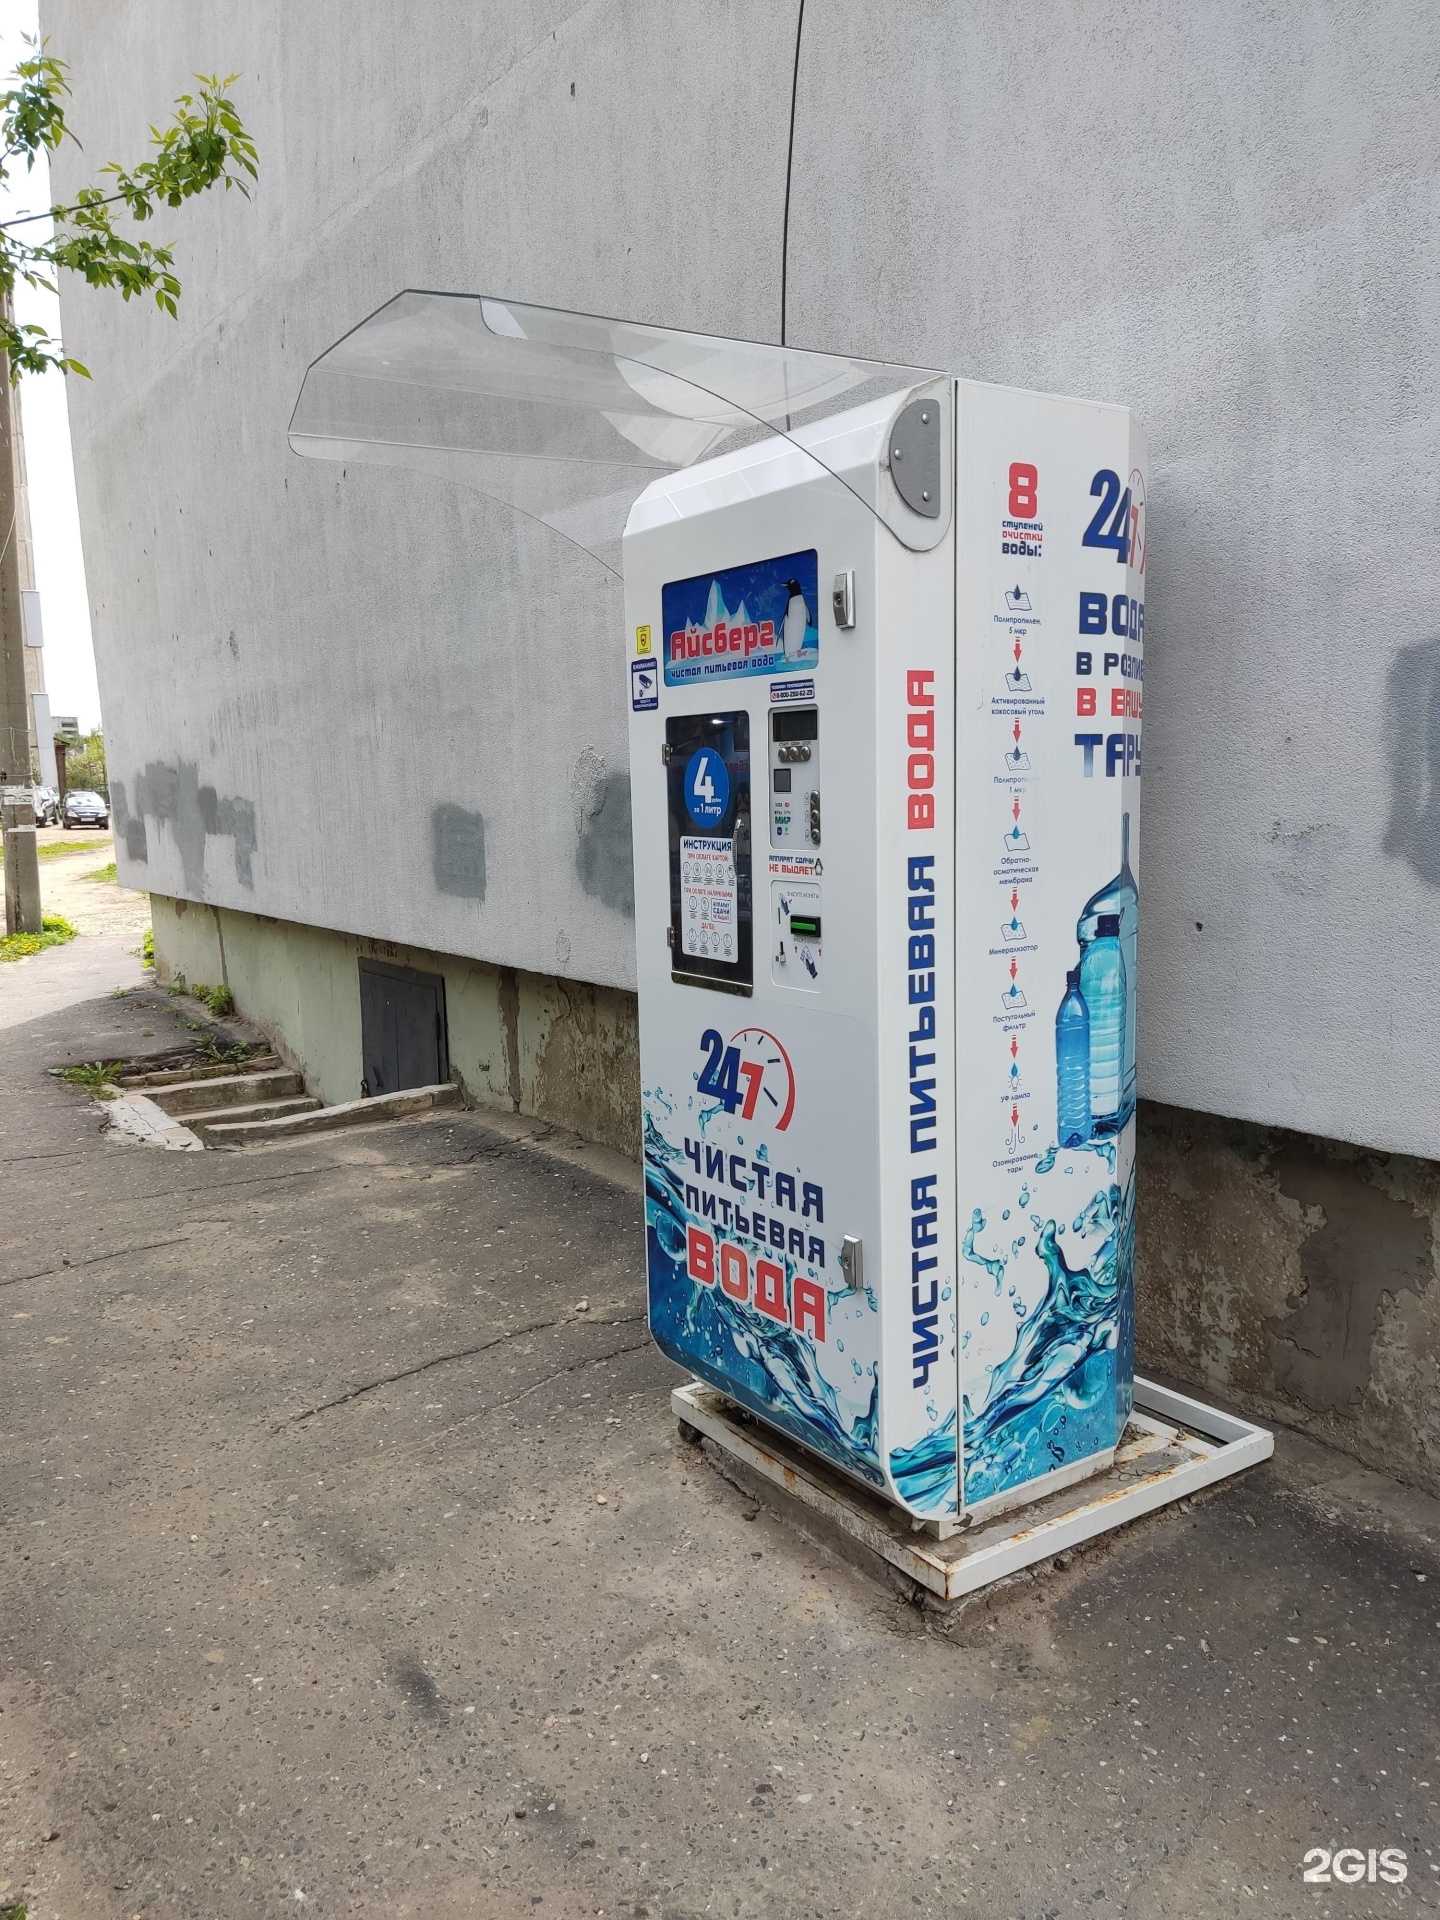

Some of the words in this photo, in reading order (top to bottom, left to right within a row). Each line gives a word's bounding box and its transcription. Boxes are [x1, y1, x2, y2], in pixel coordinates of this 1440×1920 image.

[1009, 462, 1038, 519] 8
[1002, 520, 1043, 531] ступеней
[1002, 531, 1043, 542] очистки
[1002, 540, 1042, 557] воды:
[671, 620, 775, 661] Айсберг
[671, 666, 702, 678] чистая
[704, 660, 748, 674] питьевая
[751, 654, 774, 668] вода
[1076, 652, 1092, 675] В
[991, 697, 1045, 706] Активированный
[991, 708, 1026, 716] кокосовый
[1028, 708, 1045, 716] уголь
[1077, 687, 1096, 716] В
[906, 670, 935, 829] ВОДА
[694, 757, 714, 803] 4
[683, 839, 732, 852] ИНСТРУКЦИЯ
[769, 864, 779, 872] НЕ
[781, 865, 814, 876] ВЫДАЕТ
[908, 856, 936, 1154] ПИТЬЕВАЯ
[684, 1137, 824, 1223] ЧИСТАЯ
[685, 1184, 825, 1268] ПИТЬЕВАЯ
[687, 1225, 826, 1343] ВОДА
[911, 1174, 939, 1389] ЧИСТАЯ
